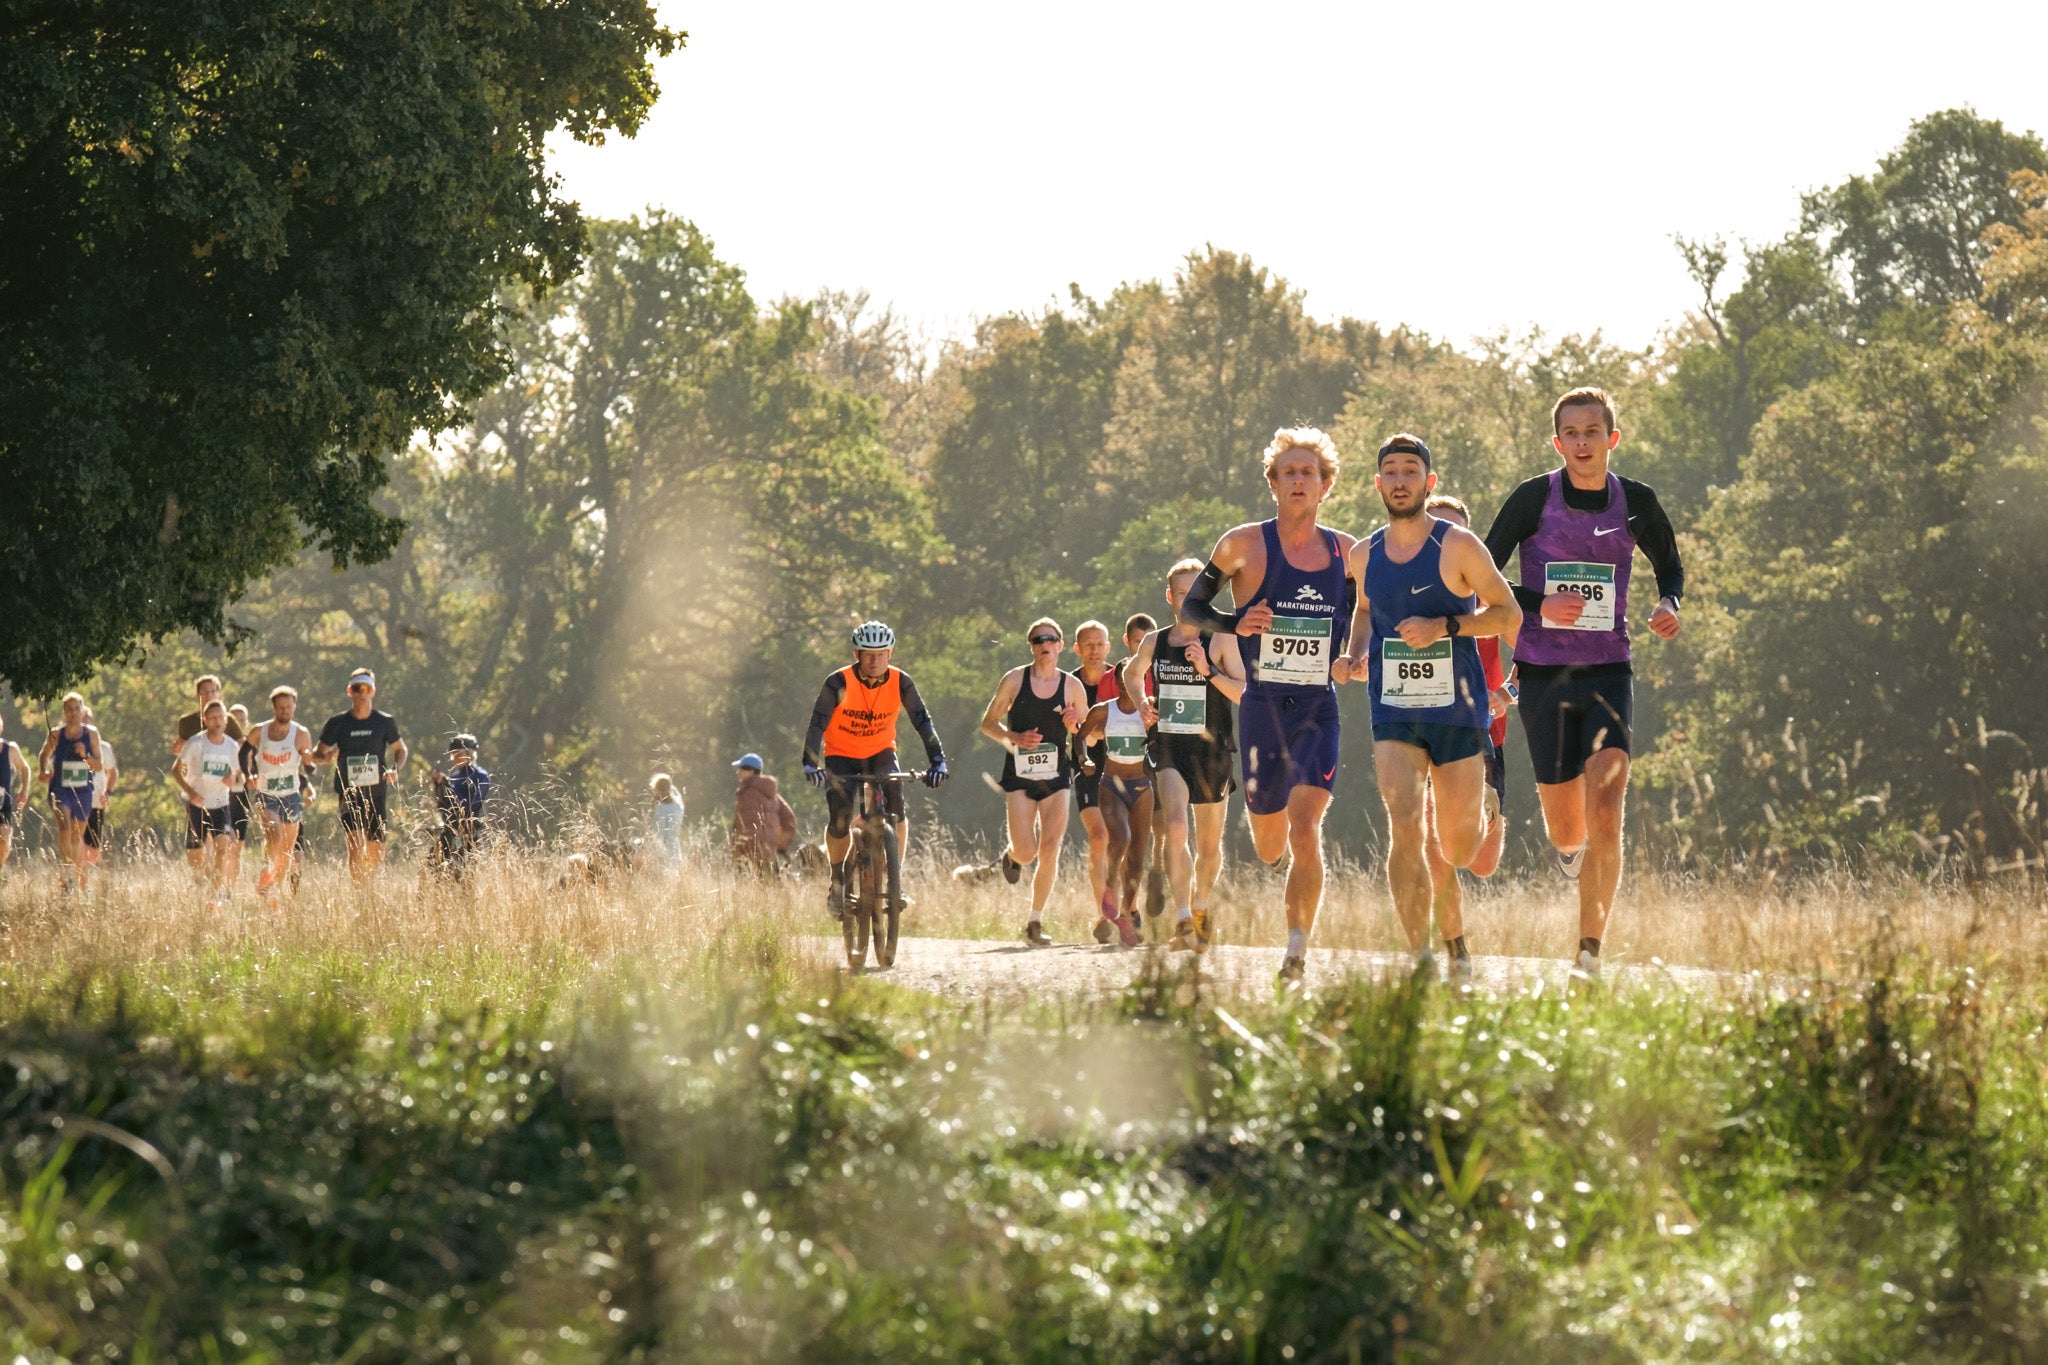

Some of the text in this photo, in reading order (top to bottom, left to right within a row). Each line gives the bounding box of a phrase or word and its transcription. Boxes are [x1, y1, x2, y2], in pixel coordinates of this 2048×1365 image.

[1276, 601, 1336, 614] MARATHONSPORT
[1272, 637, 1320, 657] 9703
[1159, 663, 1194, 672] Distance
[1398, 662, 1434, 679] 669
[1159, 672, 1207, 683] Running.dk
[1175, 700, 1185, 714] 9
[1123, 737, 1130, 748] 1
[1028, 754, 1048, 765] 692
